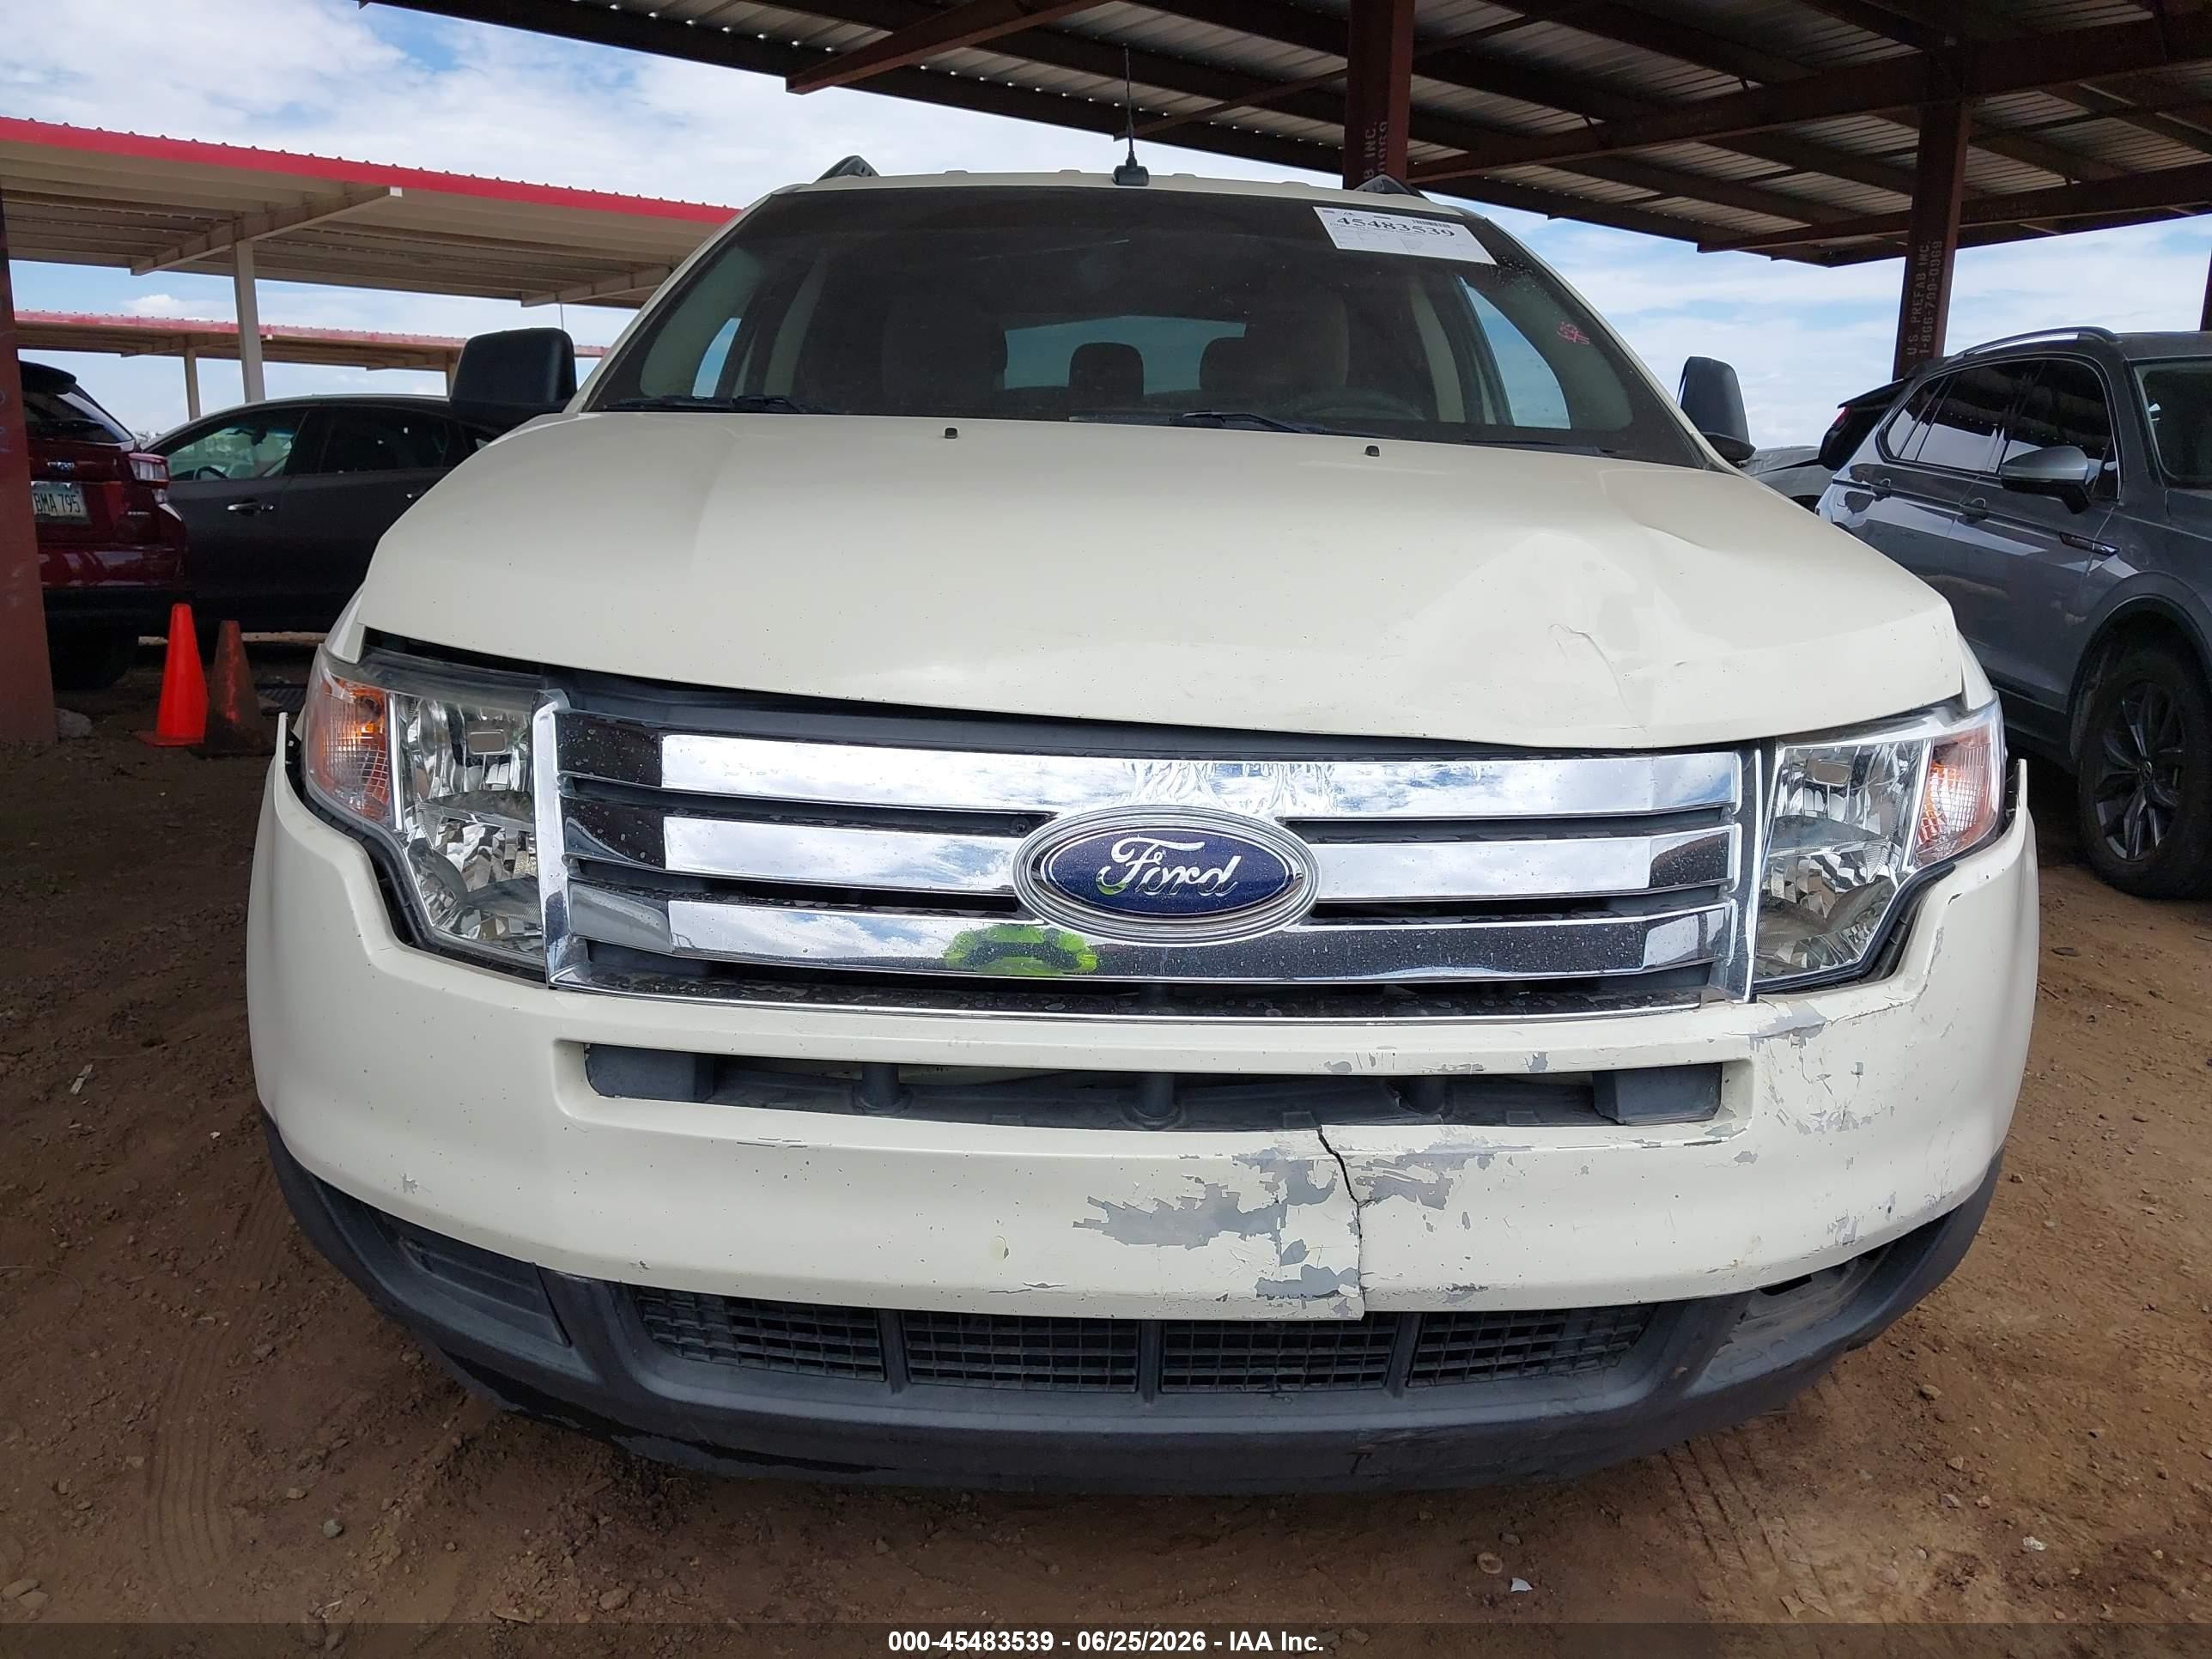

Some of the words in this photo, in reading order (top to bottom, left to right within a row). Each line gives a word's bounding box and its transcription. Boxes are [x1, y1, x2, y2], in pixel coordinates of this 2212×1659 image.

[1336, 216, 1455, 237] 45483539
[1911, 272, 1926, 324] PREFAB
[33, 493, 57, 513] BMA
[58, 493, 82, 514] 795
[1097, 836, 1242, 896] Ford
